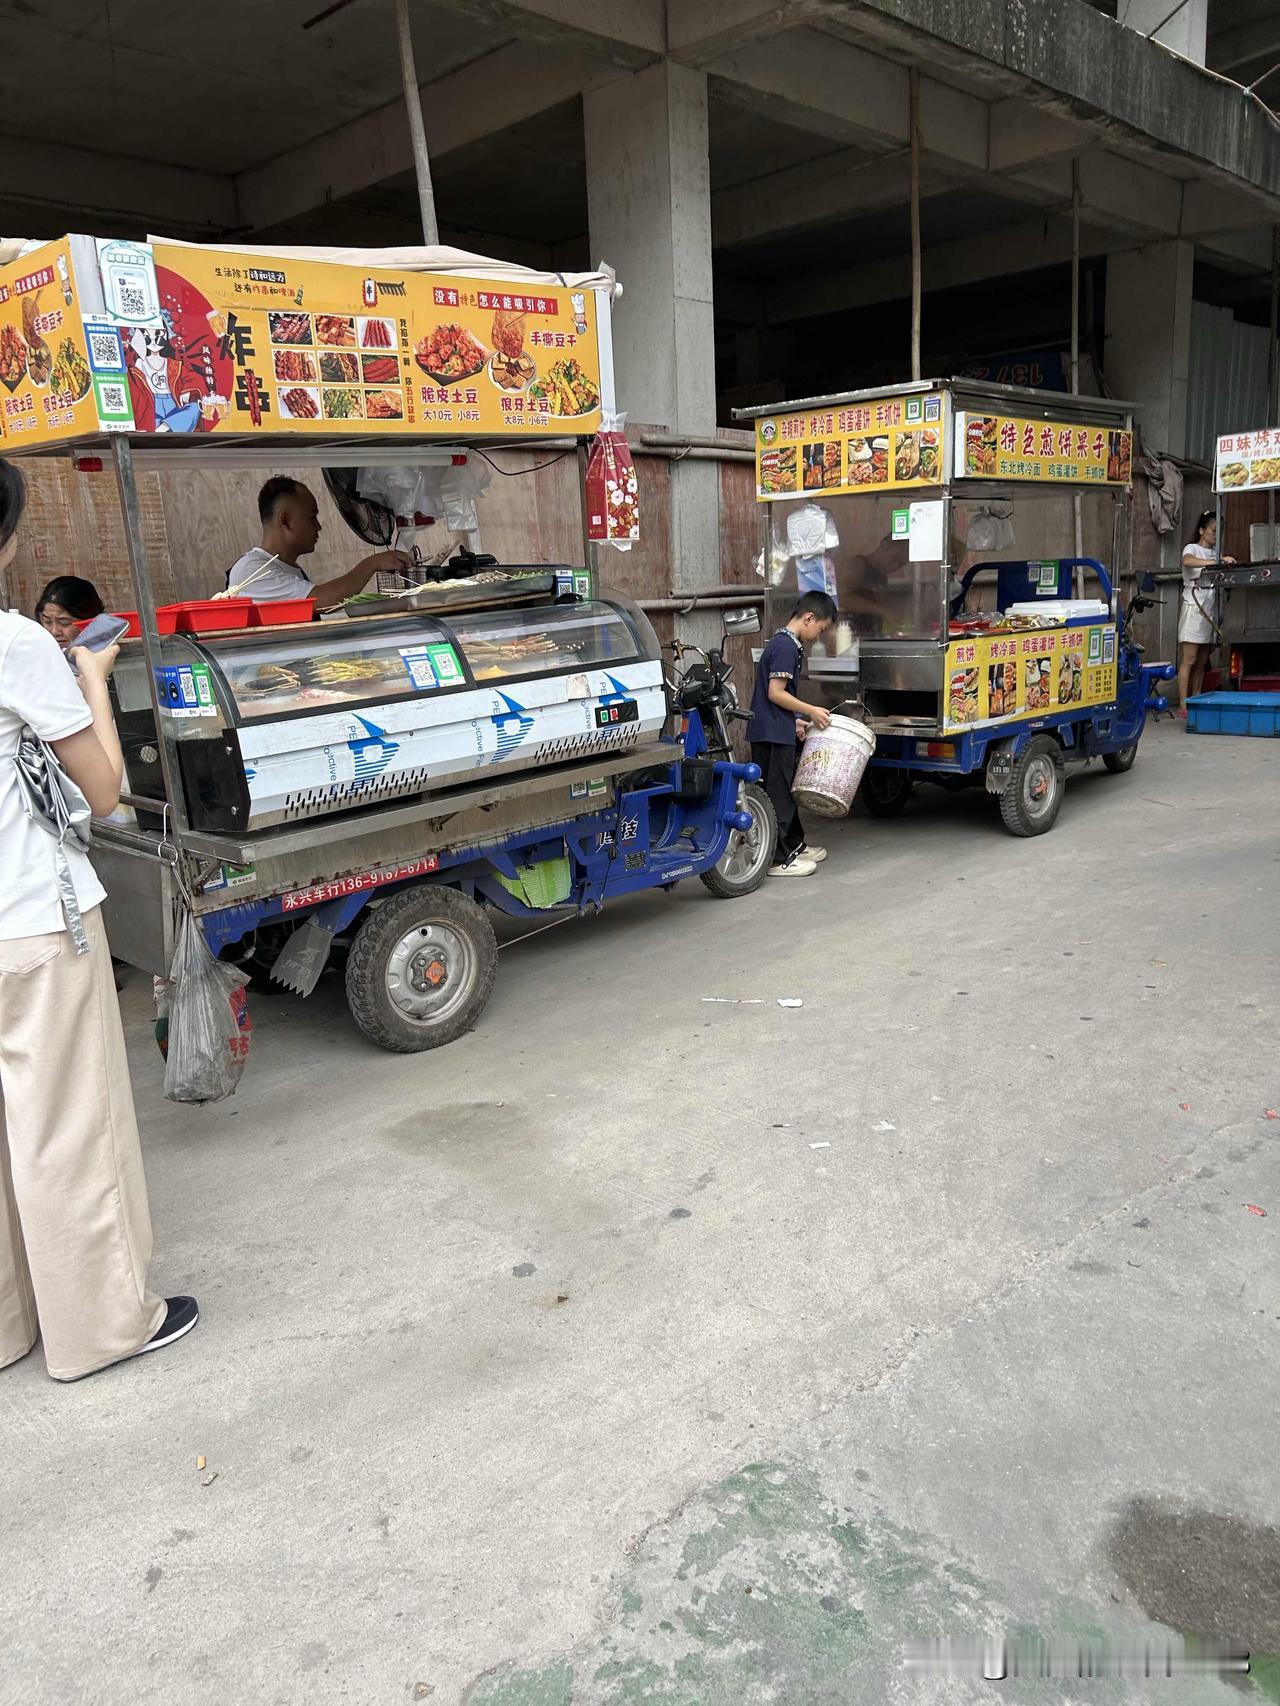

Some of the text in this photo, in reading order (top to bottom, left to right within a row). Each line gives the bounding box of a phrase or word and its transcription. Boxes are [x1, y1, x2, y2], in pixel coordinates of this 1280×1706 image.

[215, 268, 284, 283] 生活除了诗和远方
[530, 330, 577, 348] 手撕豆干
[421, 387, 478, 404] 脆皮土豆
[500, 396, 550, 413] 狼牙土豆
[423, 409, 480, 421] 大10元 小8元
[504, 415, 548, 425] 大8元 小6元
[809, 413, 834, 437] 烤冷面
[838, 408, 871, 433] 鸡蛋灌饼
[1000, 422, 1105, 460] 特色煎饼果子
[1000, 460, 1041, 476] 东北烤冷面
[1048, 464, 1078, 478] 鸡蛋灌饼
[955, 646, 975, 663] 煎饼
[990, 641, 1017, 658] 烤冷面
[1022, 635, 1056, 654] 鸡蛋灌饼
